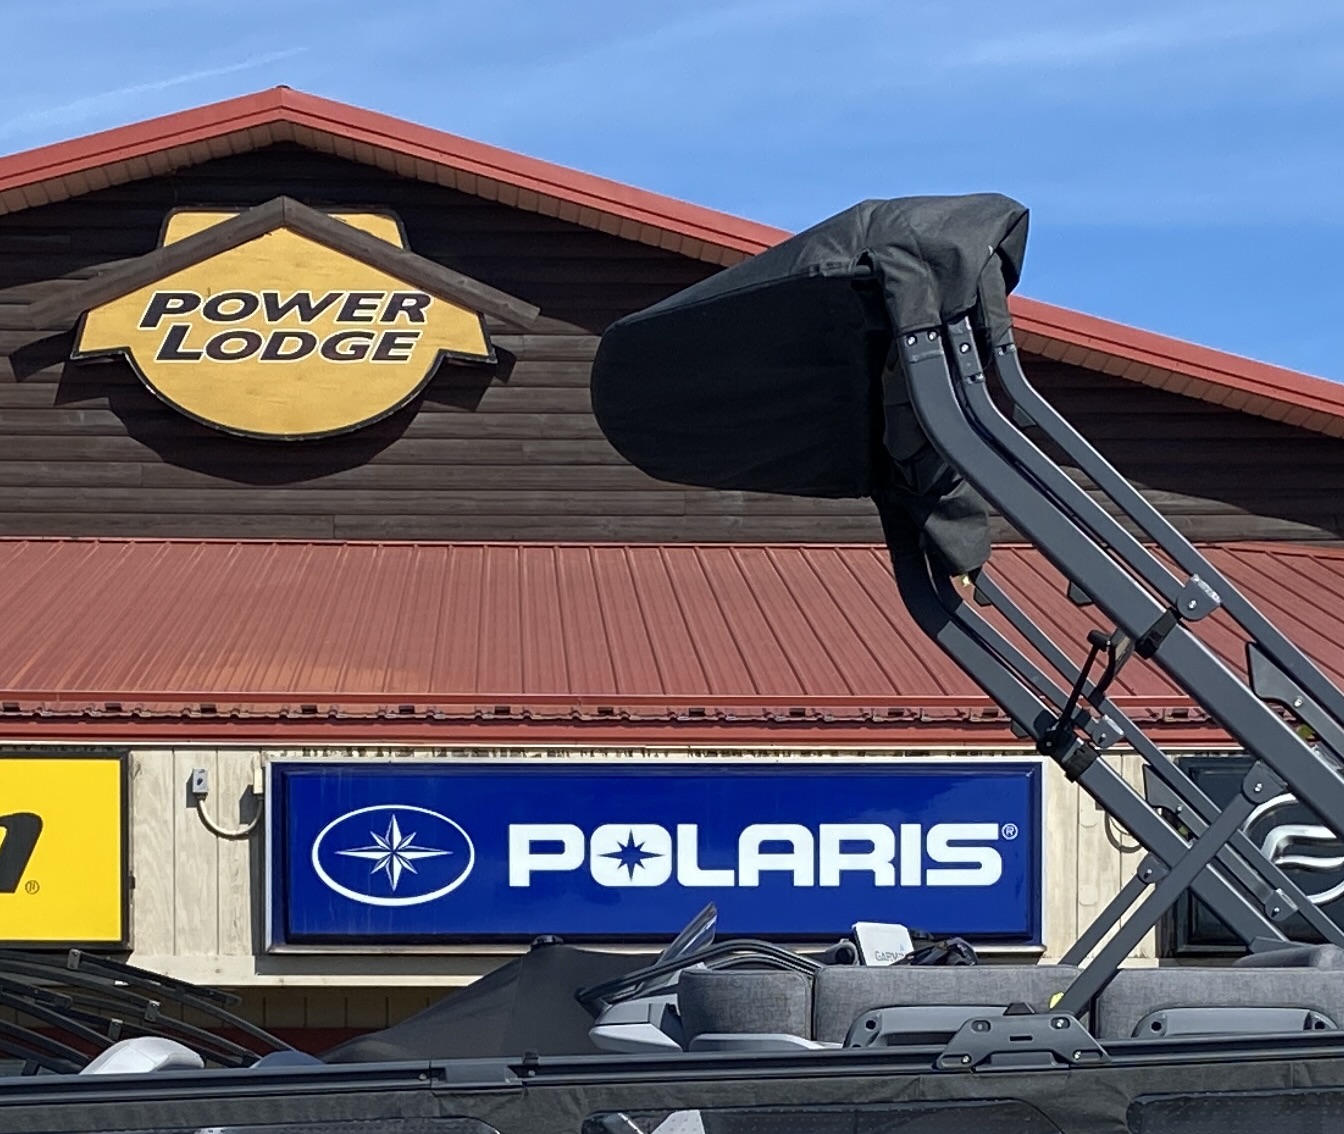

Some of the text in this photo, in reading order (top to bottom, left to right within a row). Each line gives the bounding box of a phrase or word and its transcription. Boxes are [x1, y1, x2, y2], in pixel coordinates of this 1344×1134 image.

[137, 290, 434, 330] POWER
[154, 323, 423, 365] LODGE
[508, 823, 1003, 887] POLARIS
